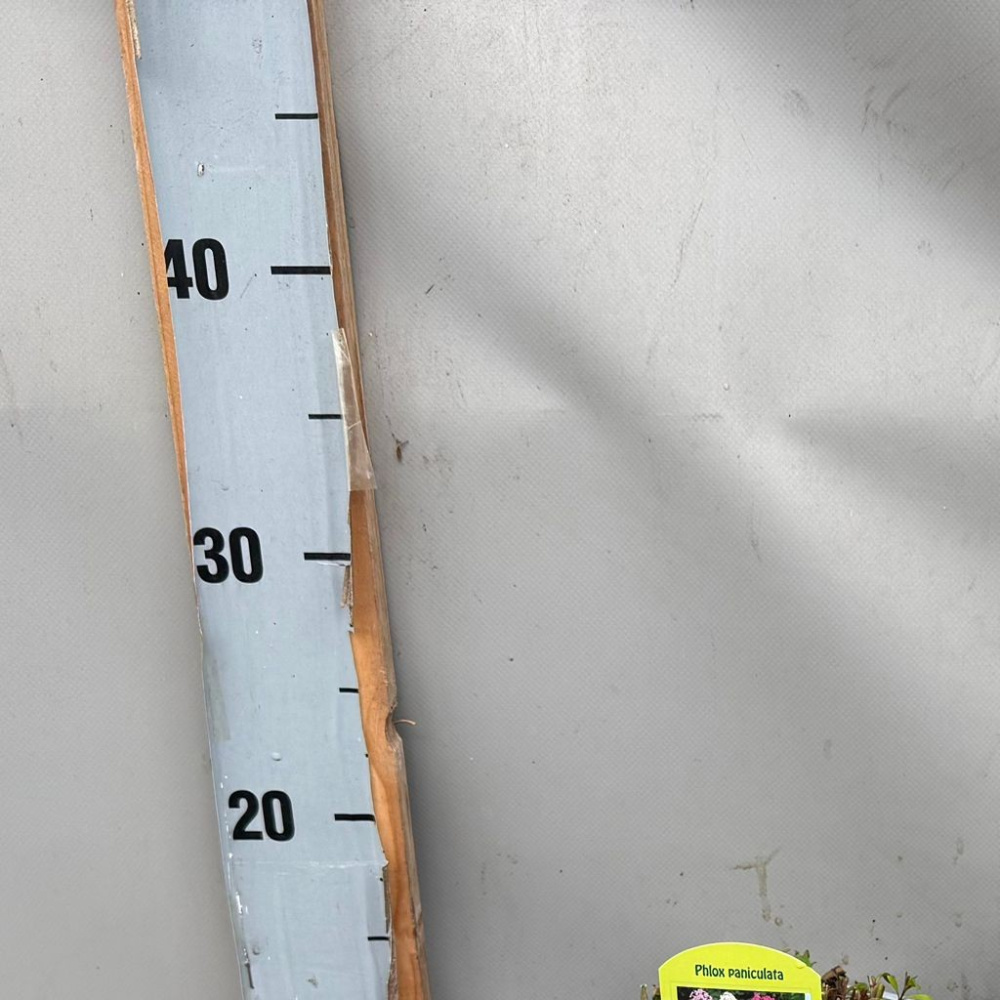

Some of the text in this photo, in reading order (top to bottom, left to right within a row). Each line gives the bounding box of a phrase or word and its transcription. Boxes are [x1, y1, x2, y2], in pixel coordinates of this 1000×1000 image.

[164, 238, 229, 300] 40
[193, 527, 263, 583] 30
[228, 790, 295, 841] 20
[695, 965, 784, 981] Phlox paniculata
